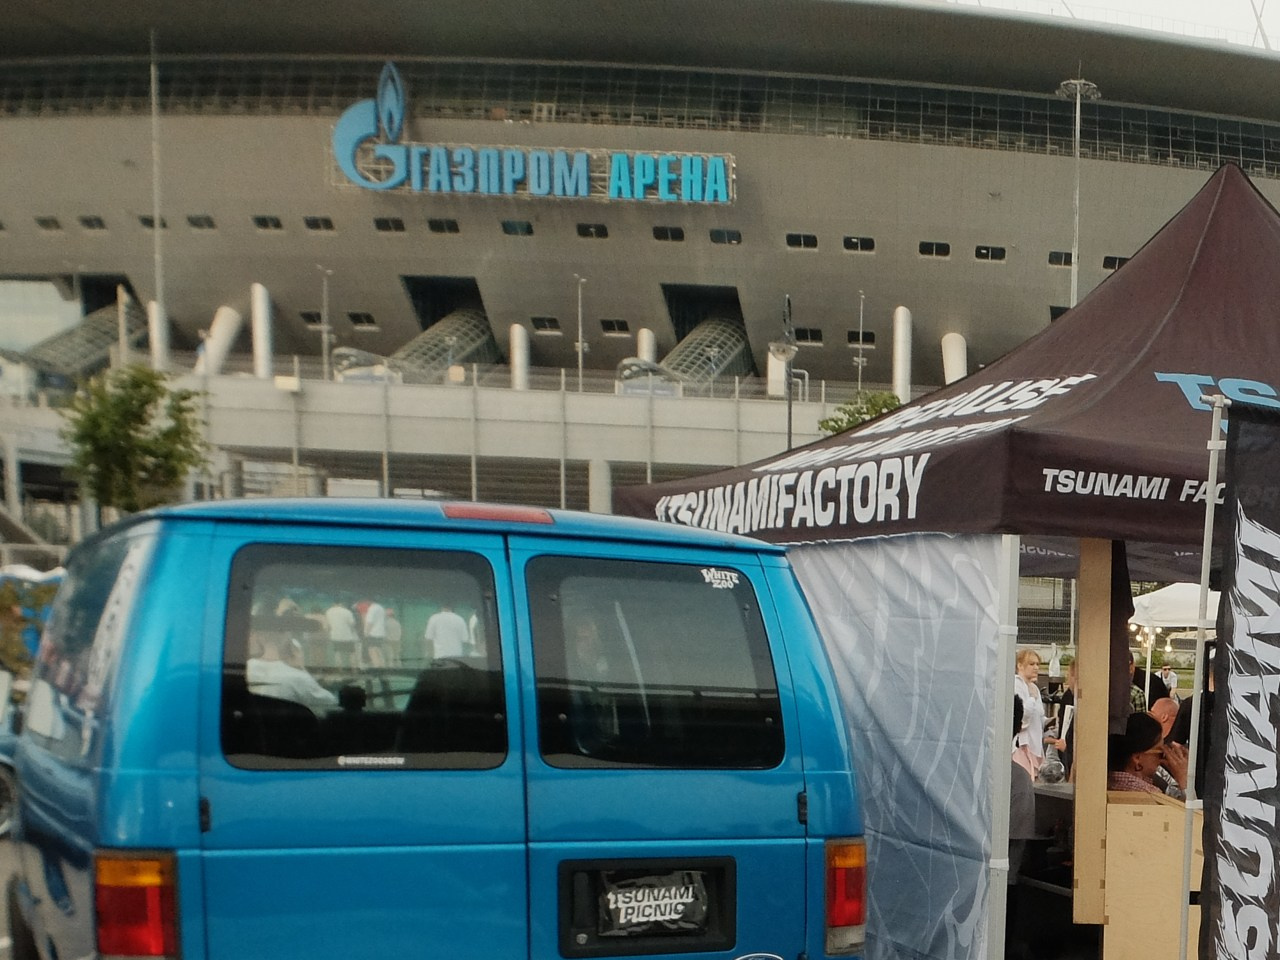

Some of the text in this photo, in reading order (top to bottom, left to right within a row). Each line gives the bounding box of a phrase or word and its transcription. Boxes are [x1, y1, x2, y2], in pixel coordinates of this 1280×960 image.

[410, 145, 728, 202] ГАЗПРОМ АРЕНА
[850, 373, 1099, 438] BECAUSE
[1042, 468, 1171, 500] TSUNAMI
[701, 567, 740, 584] WHITE
[712, 579, 735, 589] ZOO
[607, 886, 697, 909] TSUNAMI
[619, 902, 687, 924] PICNIC
